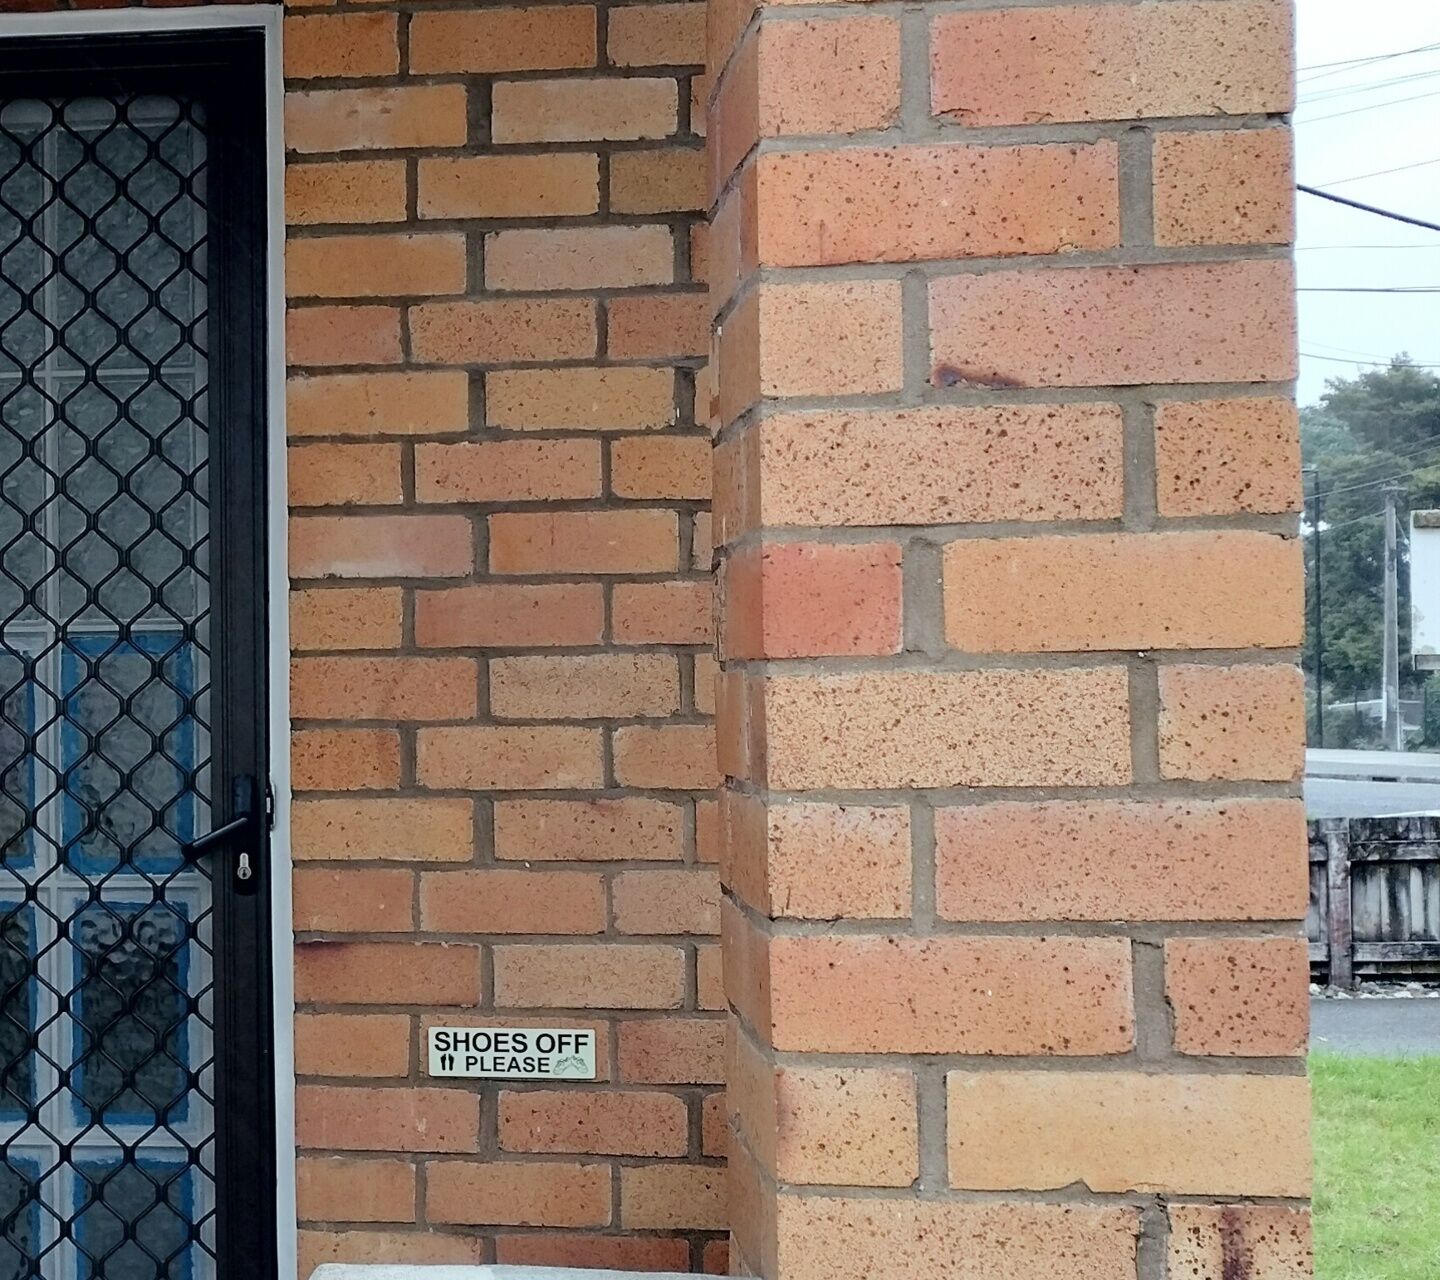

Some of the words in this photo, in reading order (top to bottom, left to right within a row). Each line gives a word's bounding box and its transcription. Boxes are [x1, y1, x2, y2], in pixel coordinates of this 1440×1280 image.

[434, 1031, 528, 1053] SHOES
[536, 1033, 589, 1054] OFF
[465, 1056, 550, 1073] PLEASE
